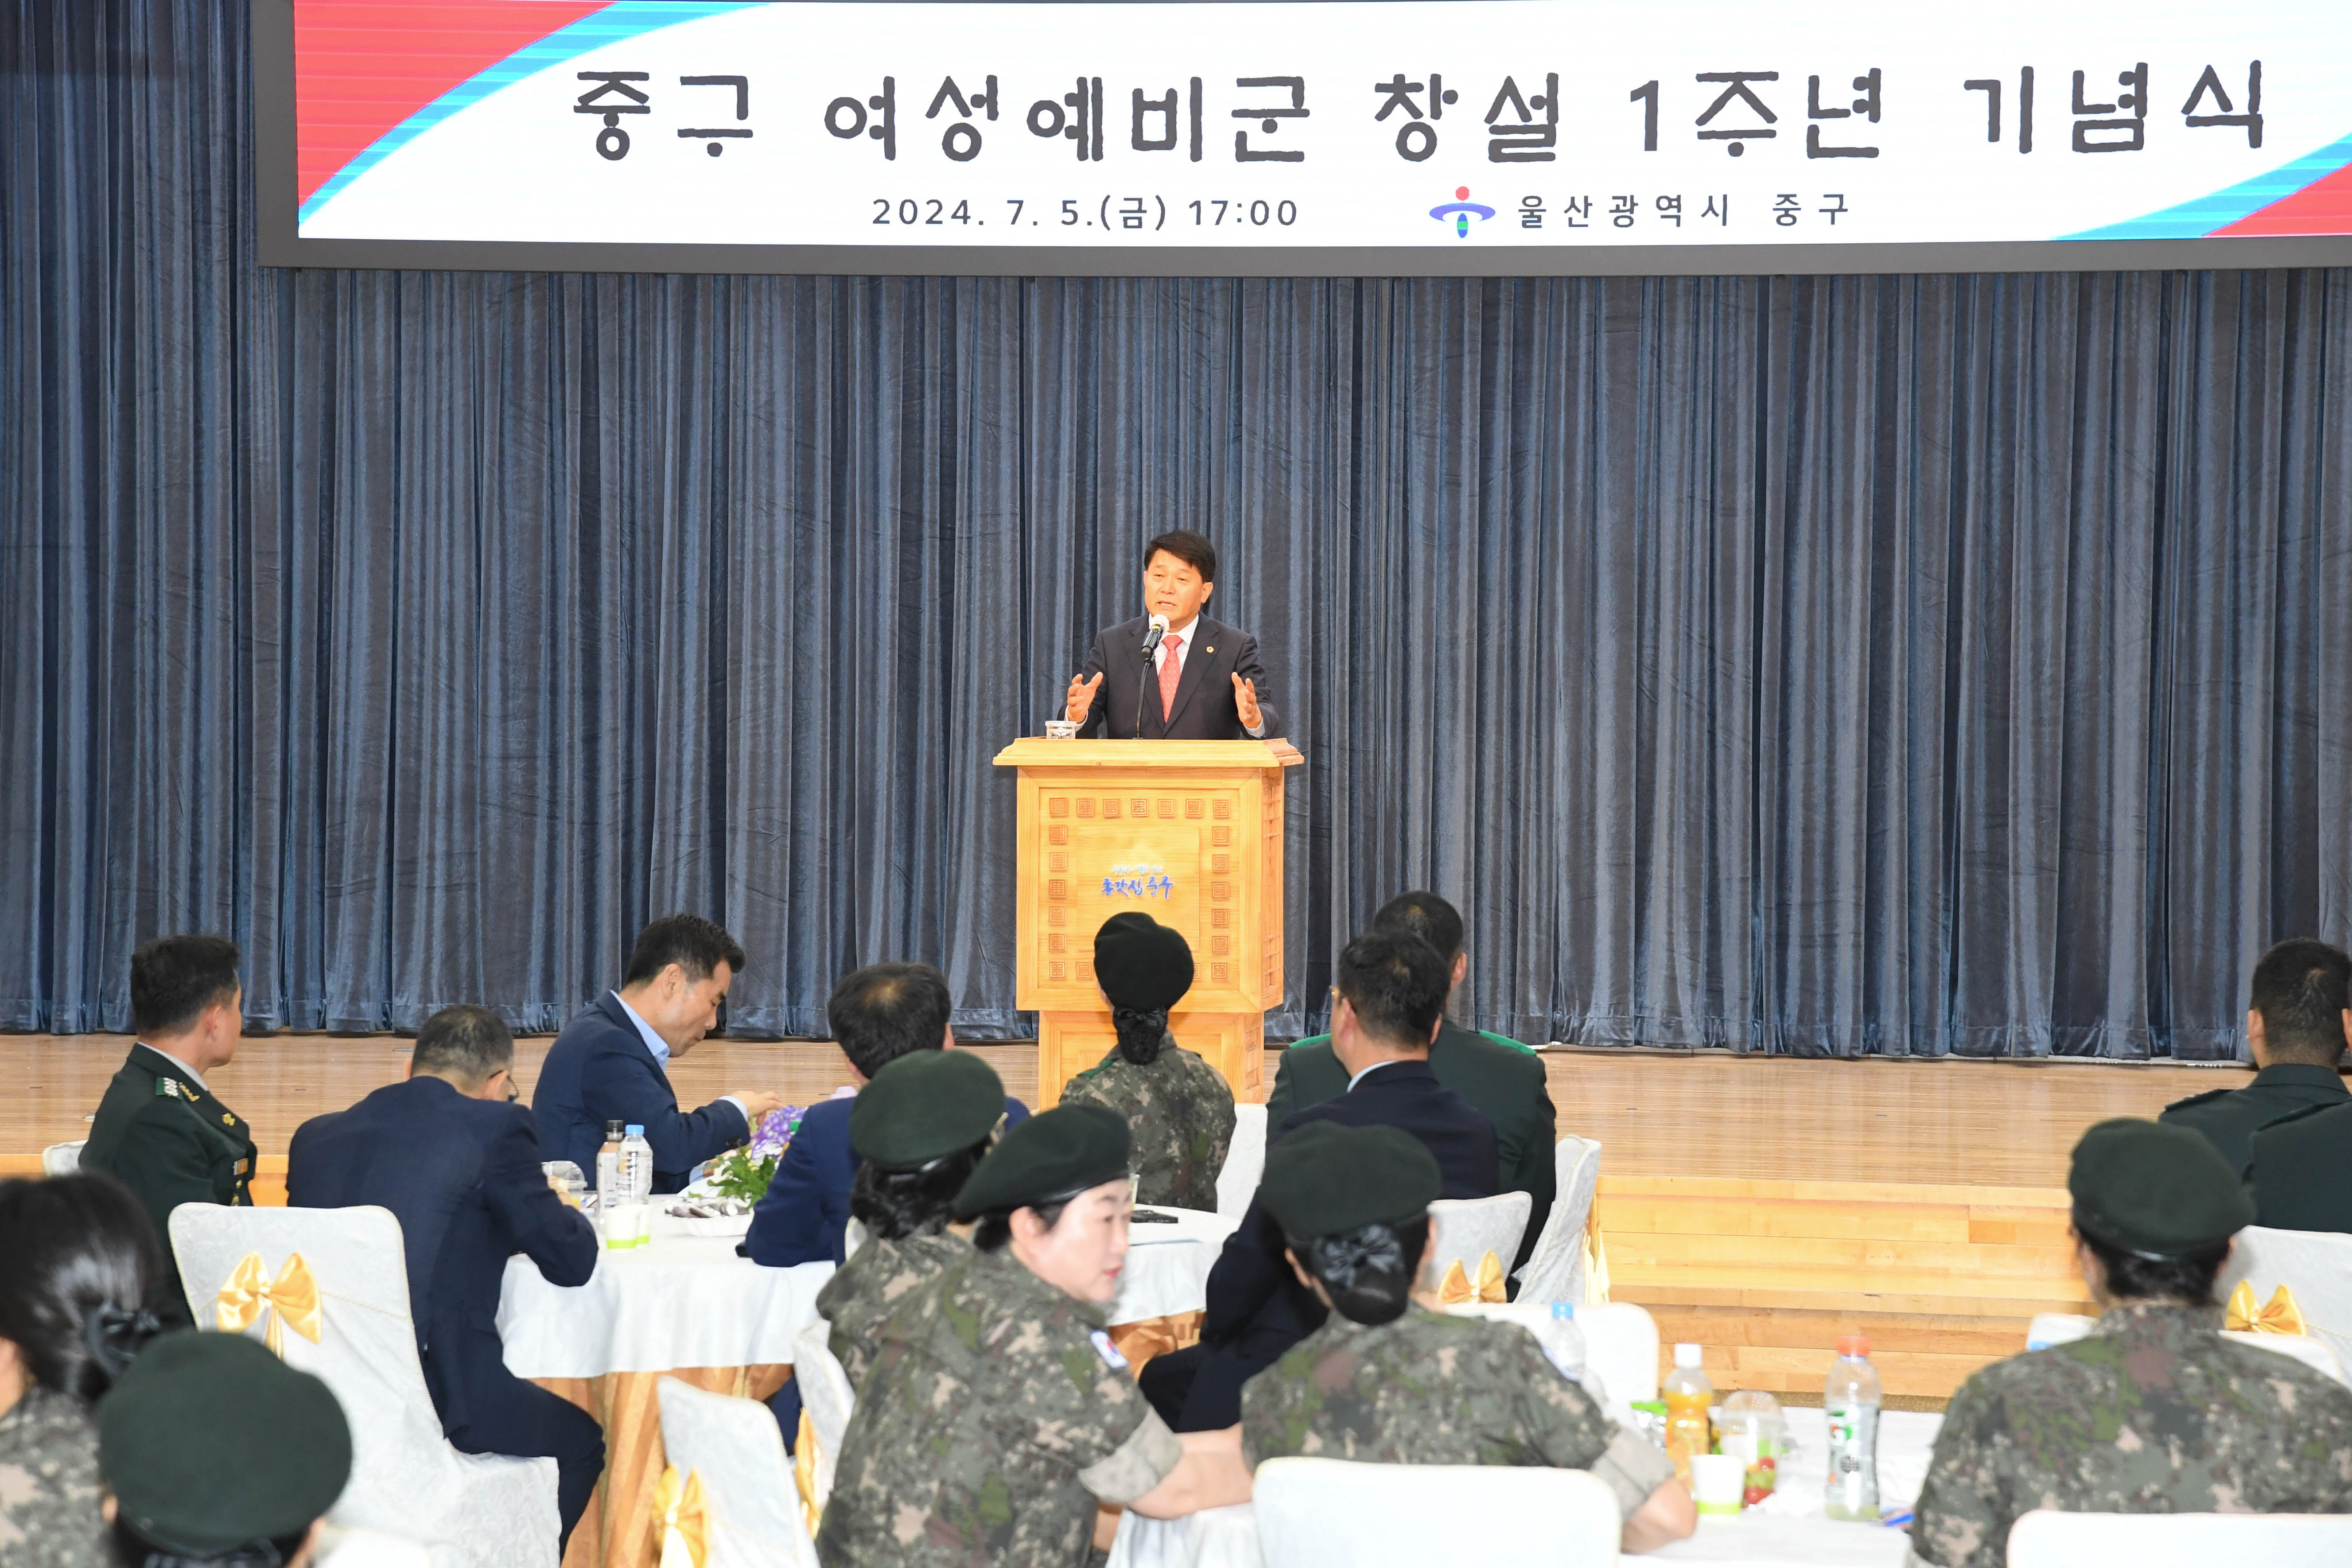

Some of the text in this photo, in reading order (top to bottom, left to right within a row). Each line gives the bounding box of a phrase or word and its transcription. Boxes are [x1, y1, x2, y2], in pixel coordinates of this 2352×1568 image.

[574, 60, 2263, 163] 중구 여성예비군 창설 1주년 기념식
[873, 195, 1296, 230] 2024. 7. 5.(금) 17:00
[1519, 194, 1848, 228] 울산광역시 중구
[1101, 875, 1174, 899] 종갓집 중구
